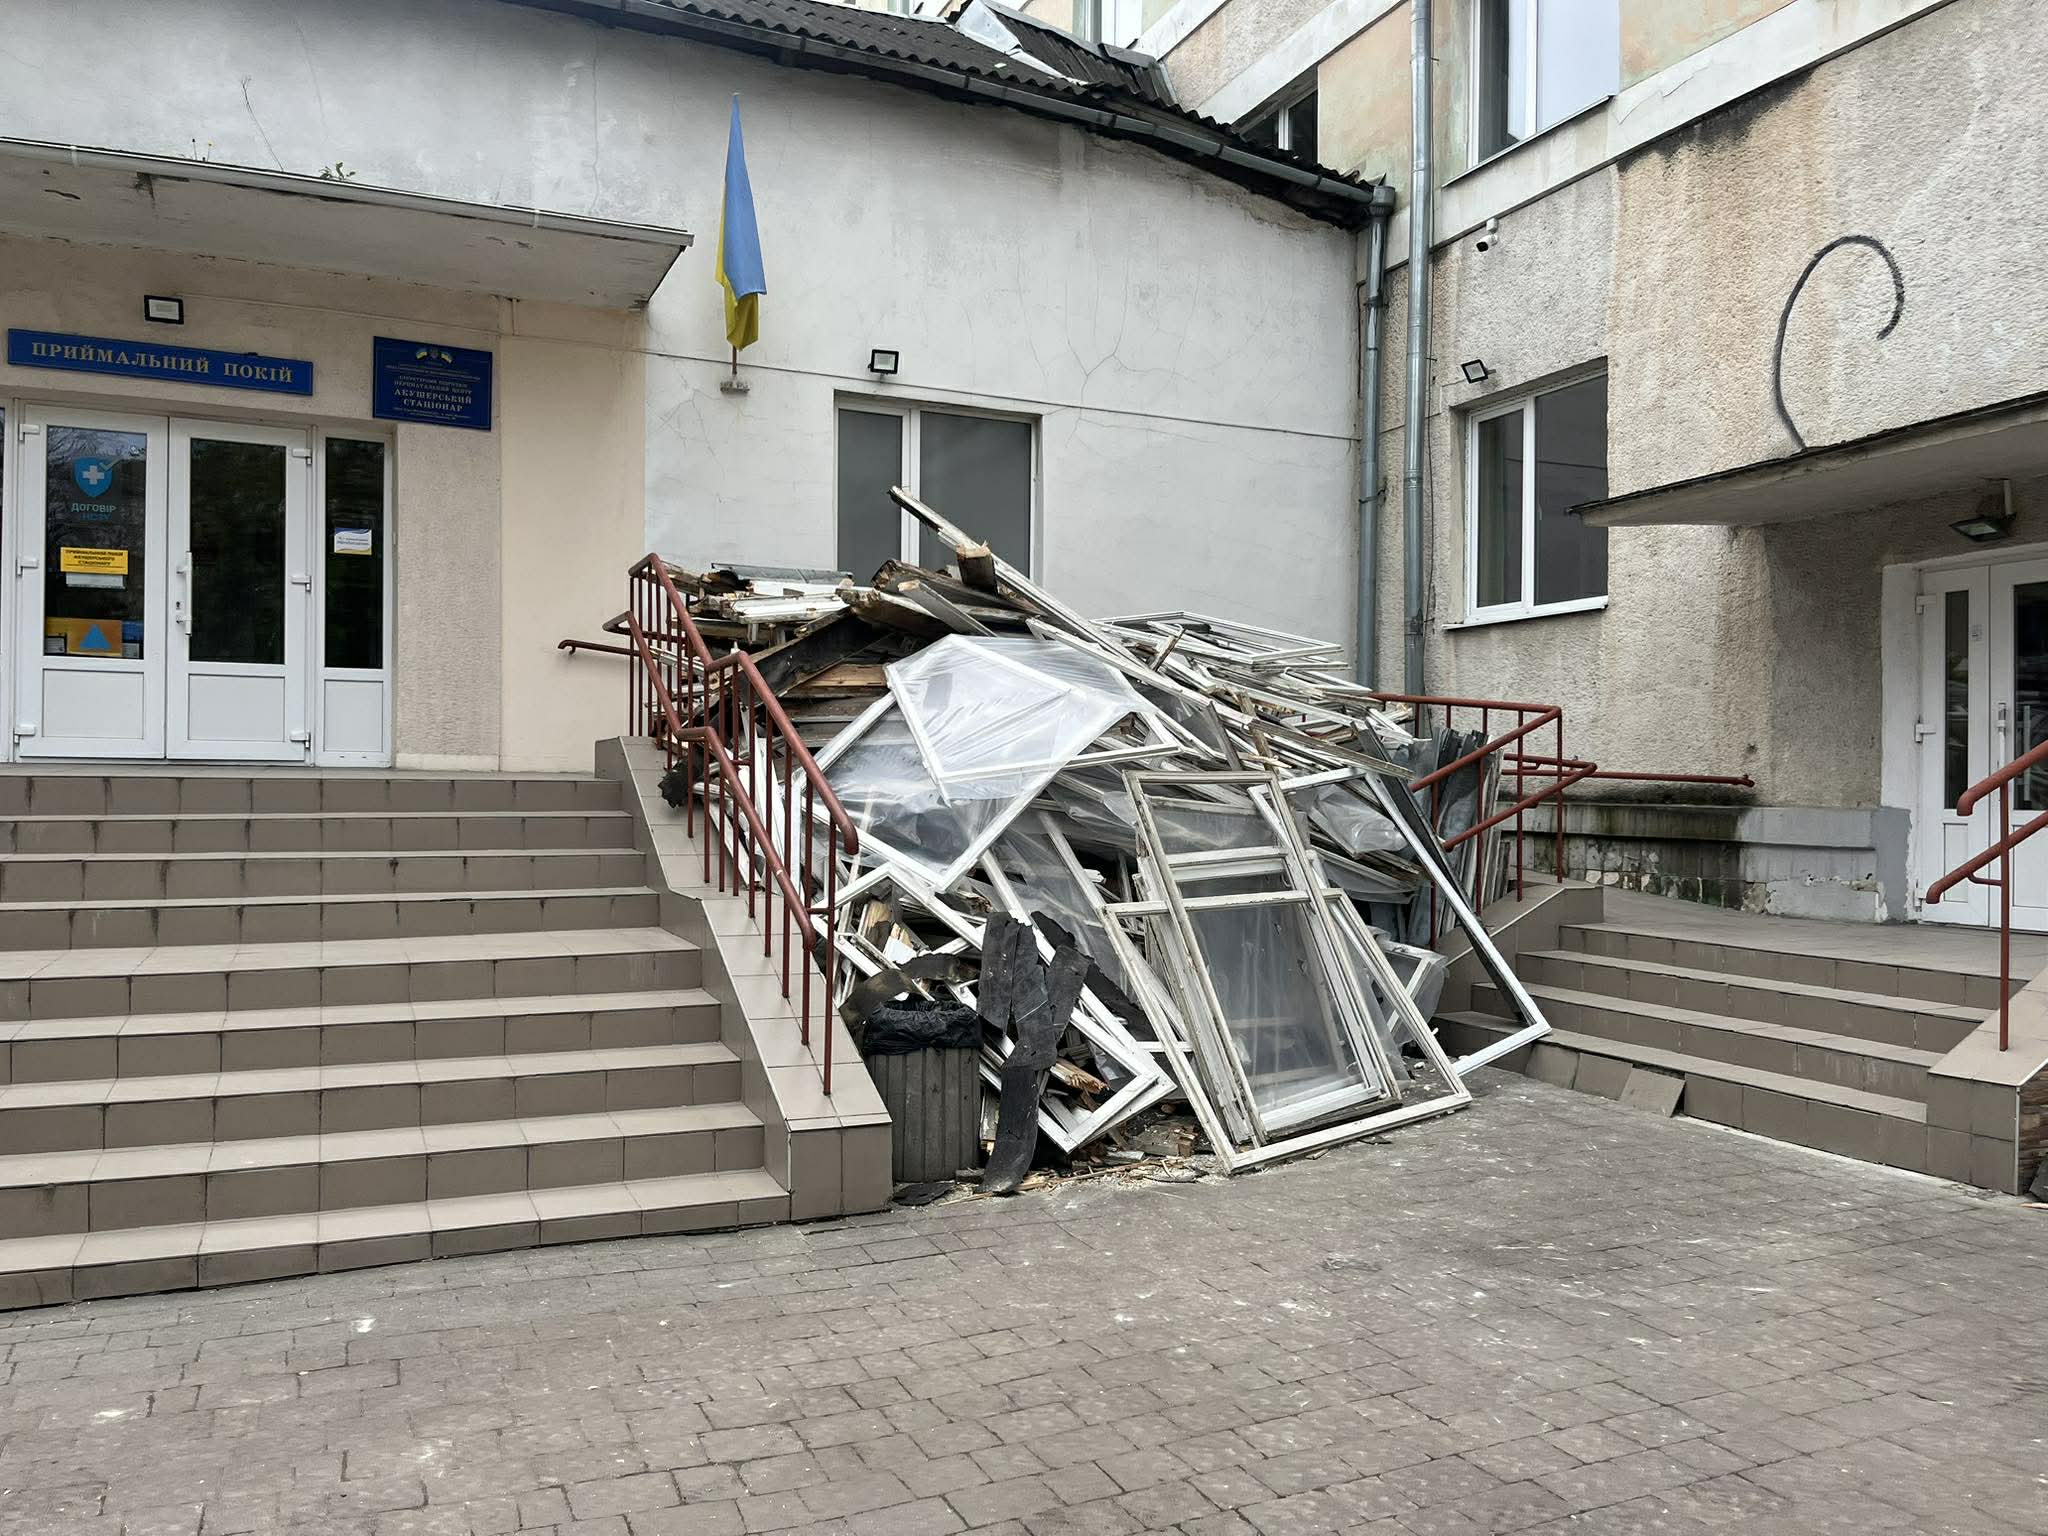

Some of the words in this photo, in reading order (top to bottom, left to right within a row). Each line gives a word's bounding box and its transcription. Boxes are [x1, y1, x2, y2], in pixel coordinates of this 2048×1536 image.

[31, 341, 210, 374] ПРИЙМАЛЬНИЙ
[223, 362, 294, 384] ПОКІЙ
[394, 388, 472, 404] АКУШЕРСЬКИЙ
[403, 398, 464, 412] СТАЦІОНАР
[71, 502, 117, 513] ДОГОВІР
